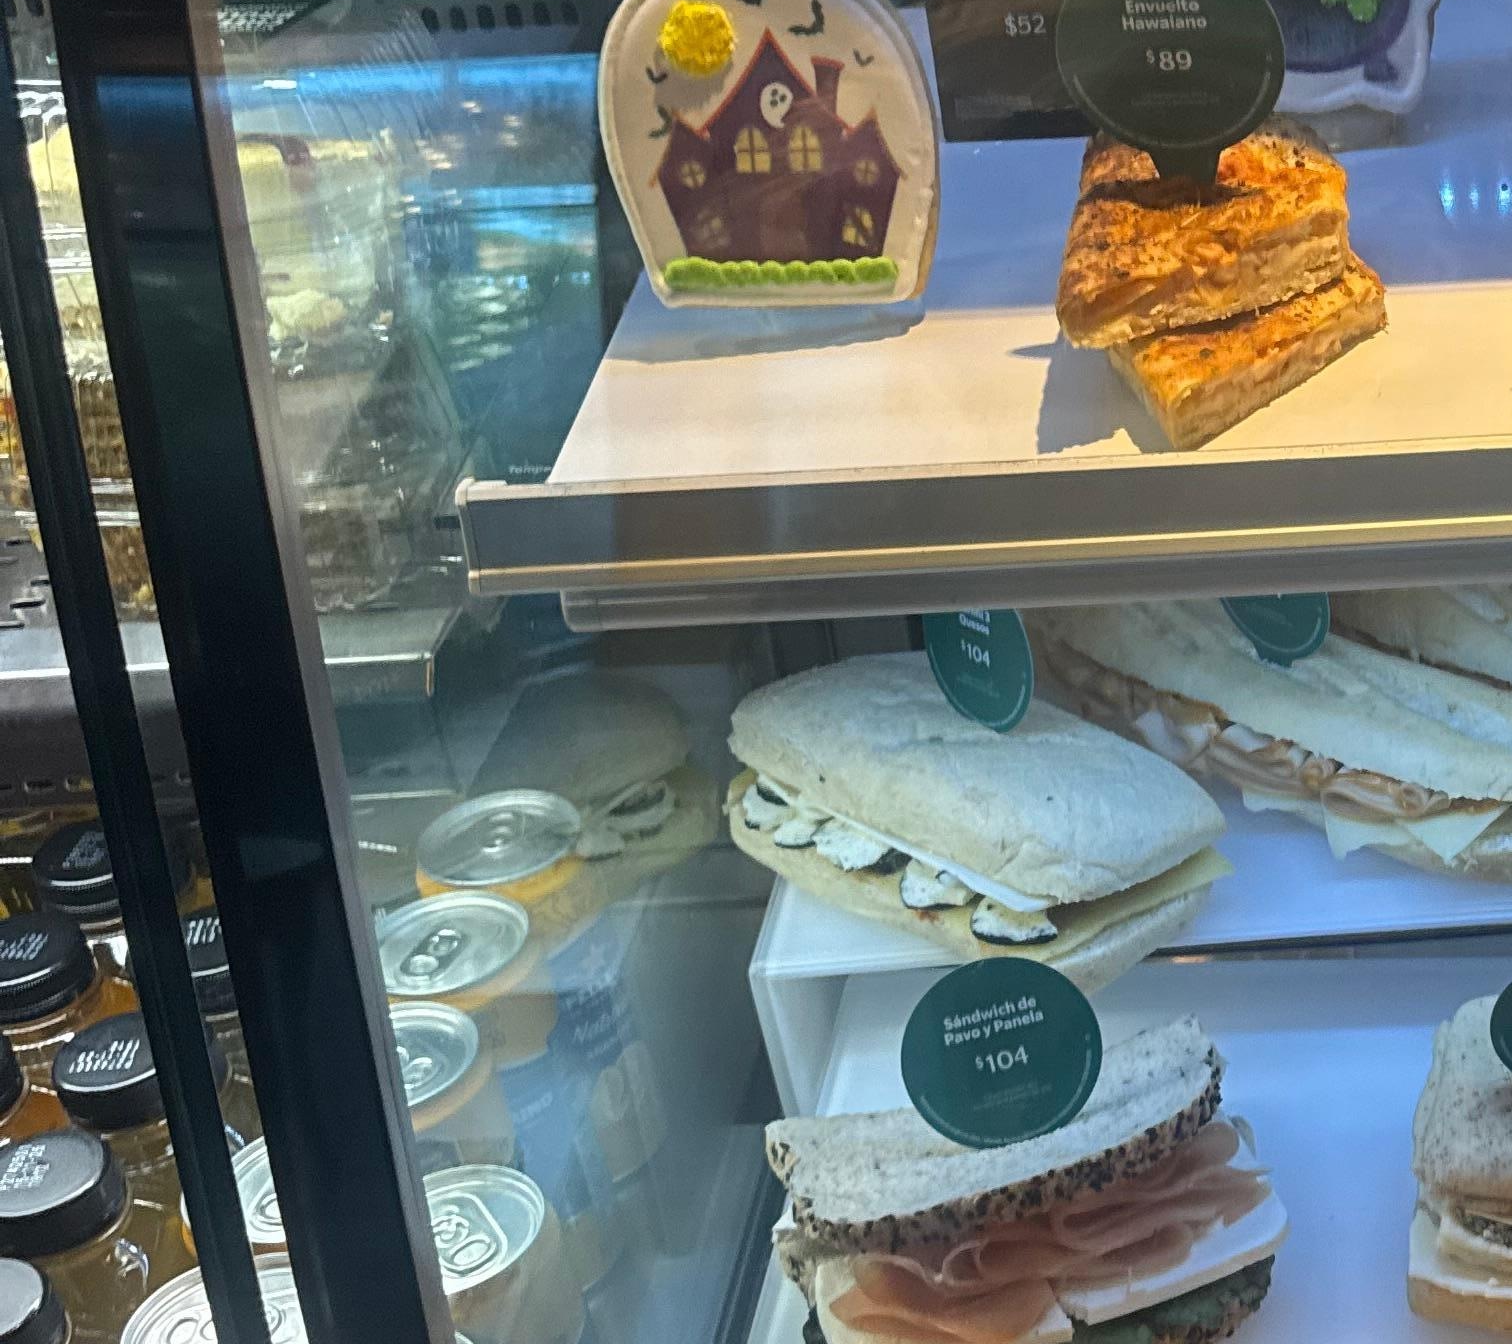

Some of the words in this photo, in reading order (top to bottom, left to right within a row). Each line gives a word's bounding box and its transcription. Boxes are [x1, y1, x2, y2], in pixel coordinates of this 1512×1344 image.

[1004, 13, 1047, 37] $52
[1122, 14, 1207, 32] Hawaiano
[1145, 49, 1193, 72] $89
[943, 999, 1015, 1031] Sándwich
[1017, 995, 1037, 1010] de
[944, 1026, 981, 1047] Pavo
[982, 1023, 991, 1038] y
[994, 1010, 1044, 1033] Panela
[975, 1045, 1029, 1074] $104
